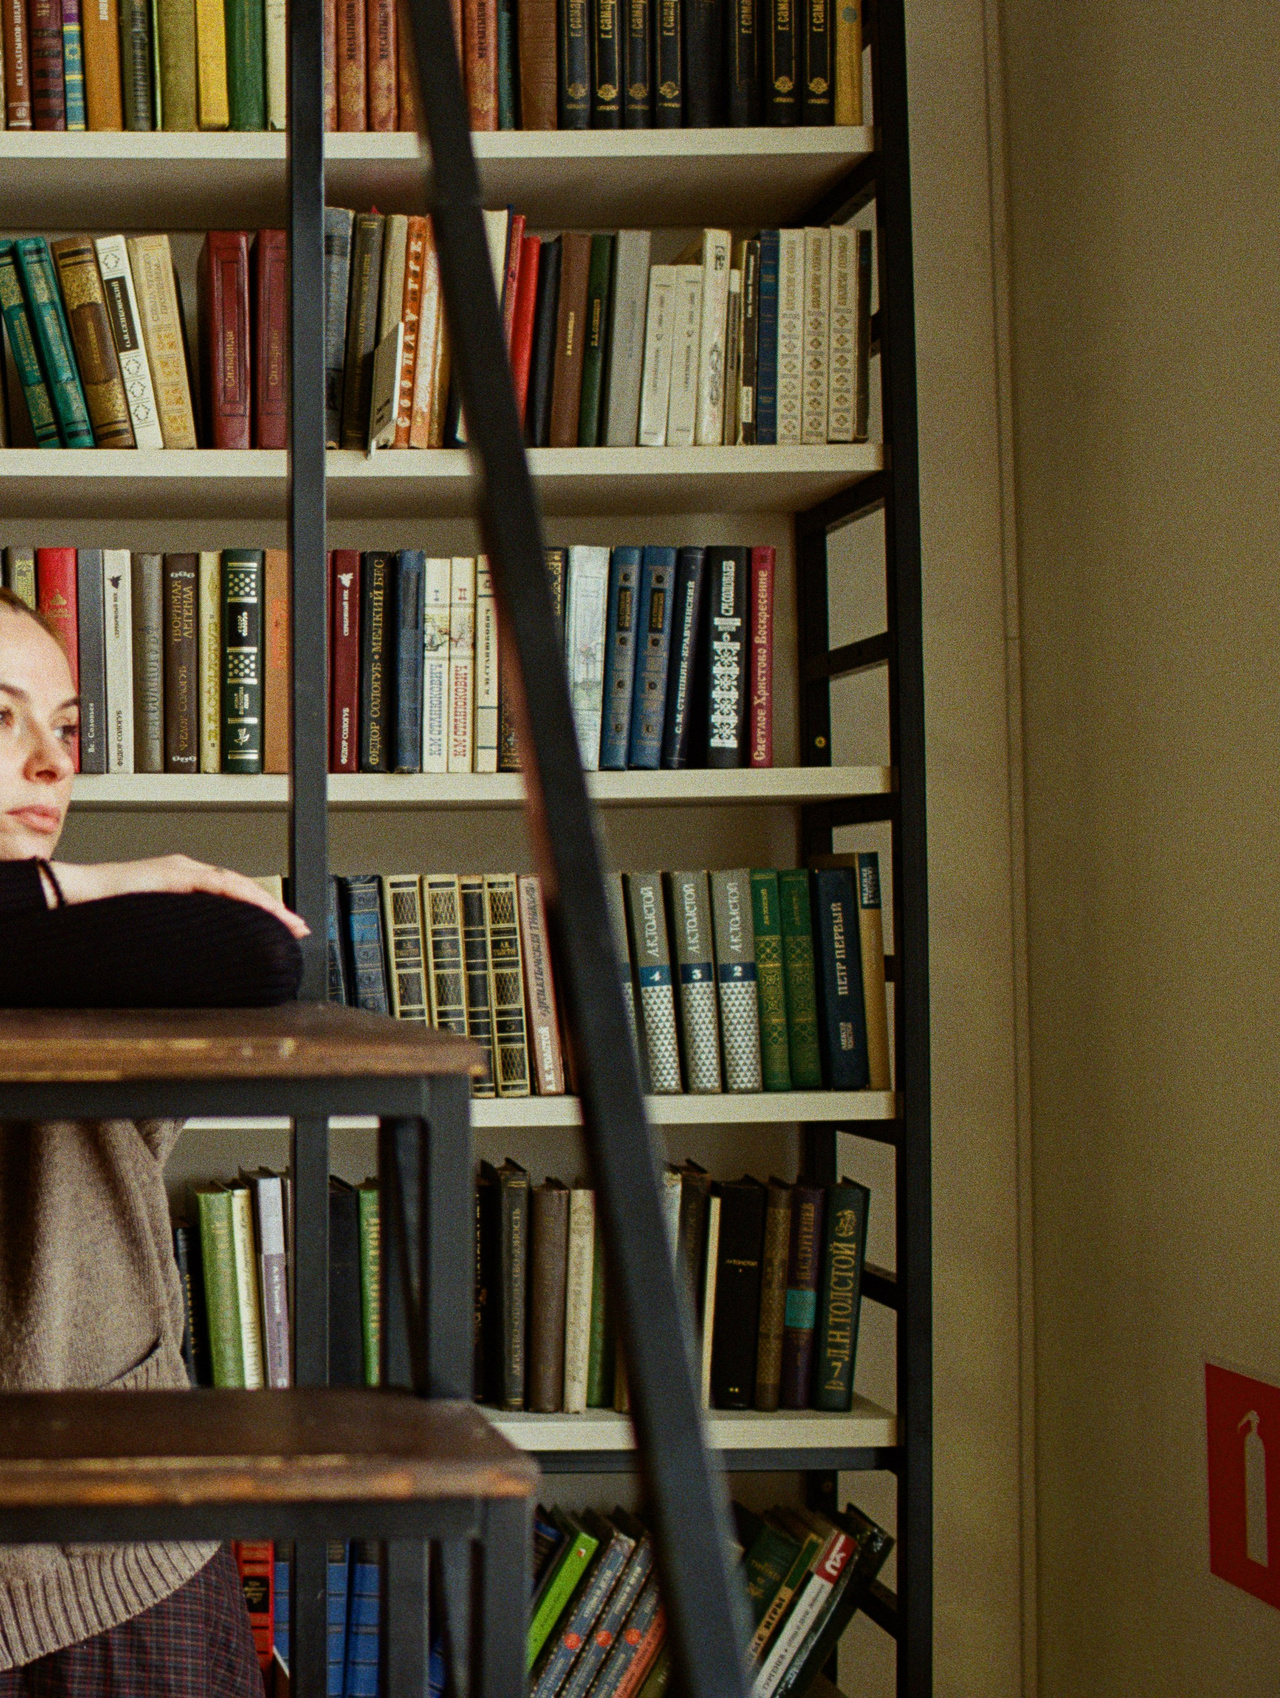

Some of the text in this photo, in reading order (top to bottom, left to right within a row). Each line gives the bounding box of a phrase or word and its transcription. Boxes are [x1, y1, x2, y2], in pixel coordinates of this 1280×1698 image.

[171, 580, 182, 643] ТВОРИМАЯ
[183, 585, 194, 639] ЛЕГЕНДА
[370, 559, 385, 766] ФЕДОР СОЛОГУБ МЕЛКИЙ БЕС
[753, 569, 770, 762] Светлое Христово Воскресение
[87, 702, 95, 739] Соловьев
[177, 665, 188, 750] ФЕДОР СОЛОГУБ
[429, 664, 443, 736] СТАНЮКОВИЧ
[453, 665, 468, 737] СТАНЮКОВИЧ
[115, 710, 124, 767] ФЕДОР СОЛОГУБ
[340, 707, 350, 765] ФЕДОР СОЛОГУБ
[650, 970, 662, 982] 4
[691, 968, 703, 980] 3
[732, 965, 743, 977] 2
[830, 902, 849, 996] ПЕТР ПЕРВЫЙ
[538, 1026, 553, 1070] ТОЛСТОЙ
[825, 1241, 856, 1361] Л.Н.ТОЛСТОЙ
[830, 1361, 842, 1379] 7
[762, 1598, 785, 1631] ИГРЫ
